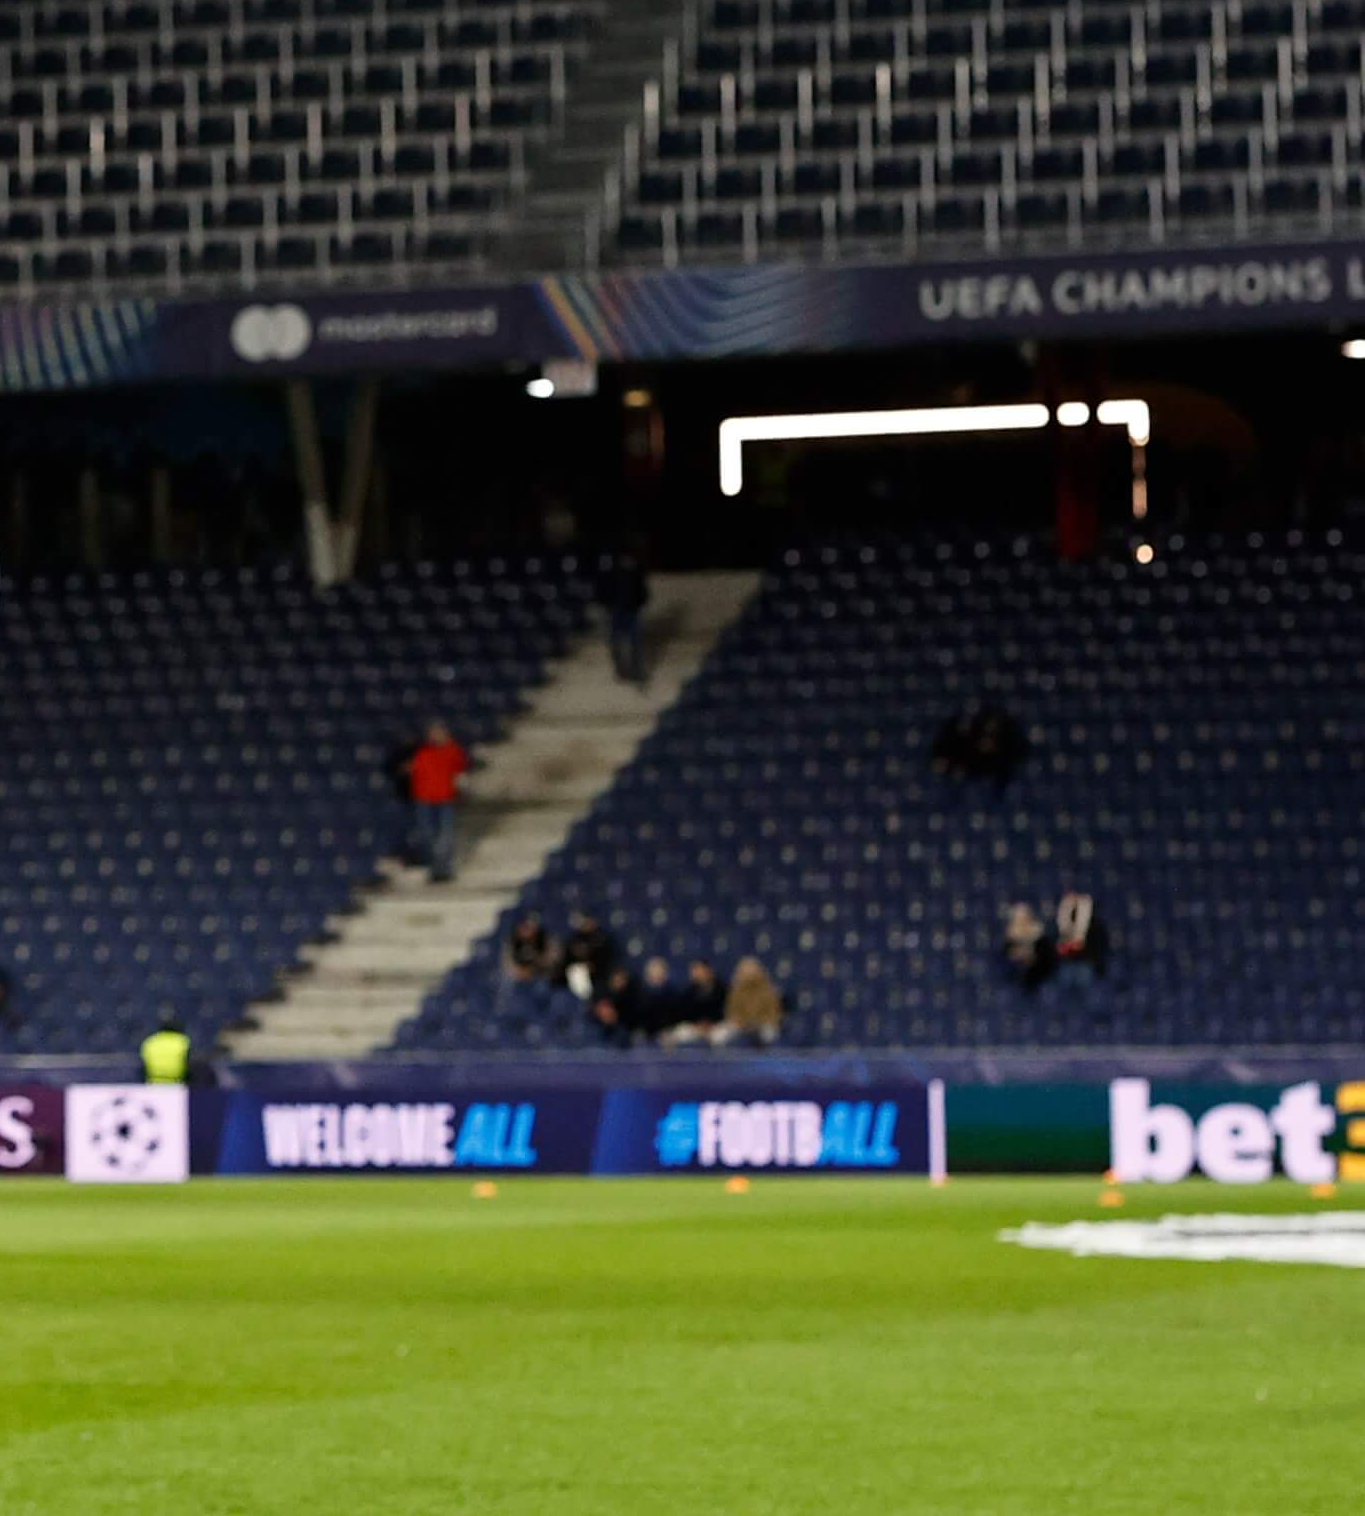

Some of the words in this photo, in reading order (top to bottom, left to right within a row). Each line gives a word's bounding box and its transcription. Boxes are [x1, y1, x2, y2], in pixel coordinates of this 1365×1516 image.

[917, 274, 1045, 322] UEFA
[1051, 255, 1333, 315] CHAMPIONS
[261, 1101, 457, 1168] WELCOME
[454, 1101, 539, 1168] ALL
[654, 1100, 901, 1168] #FOOTBALL
